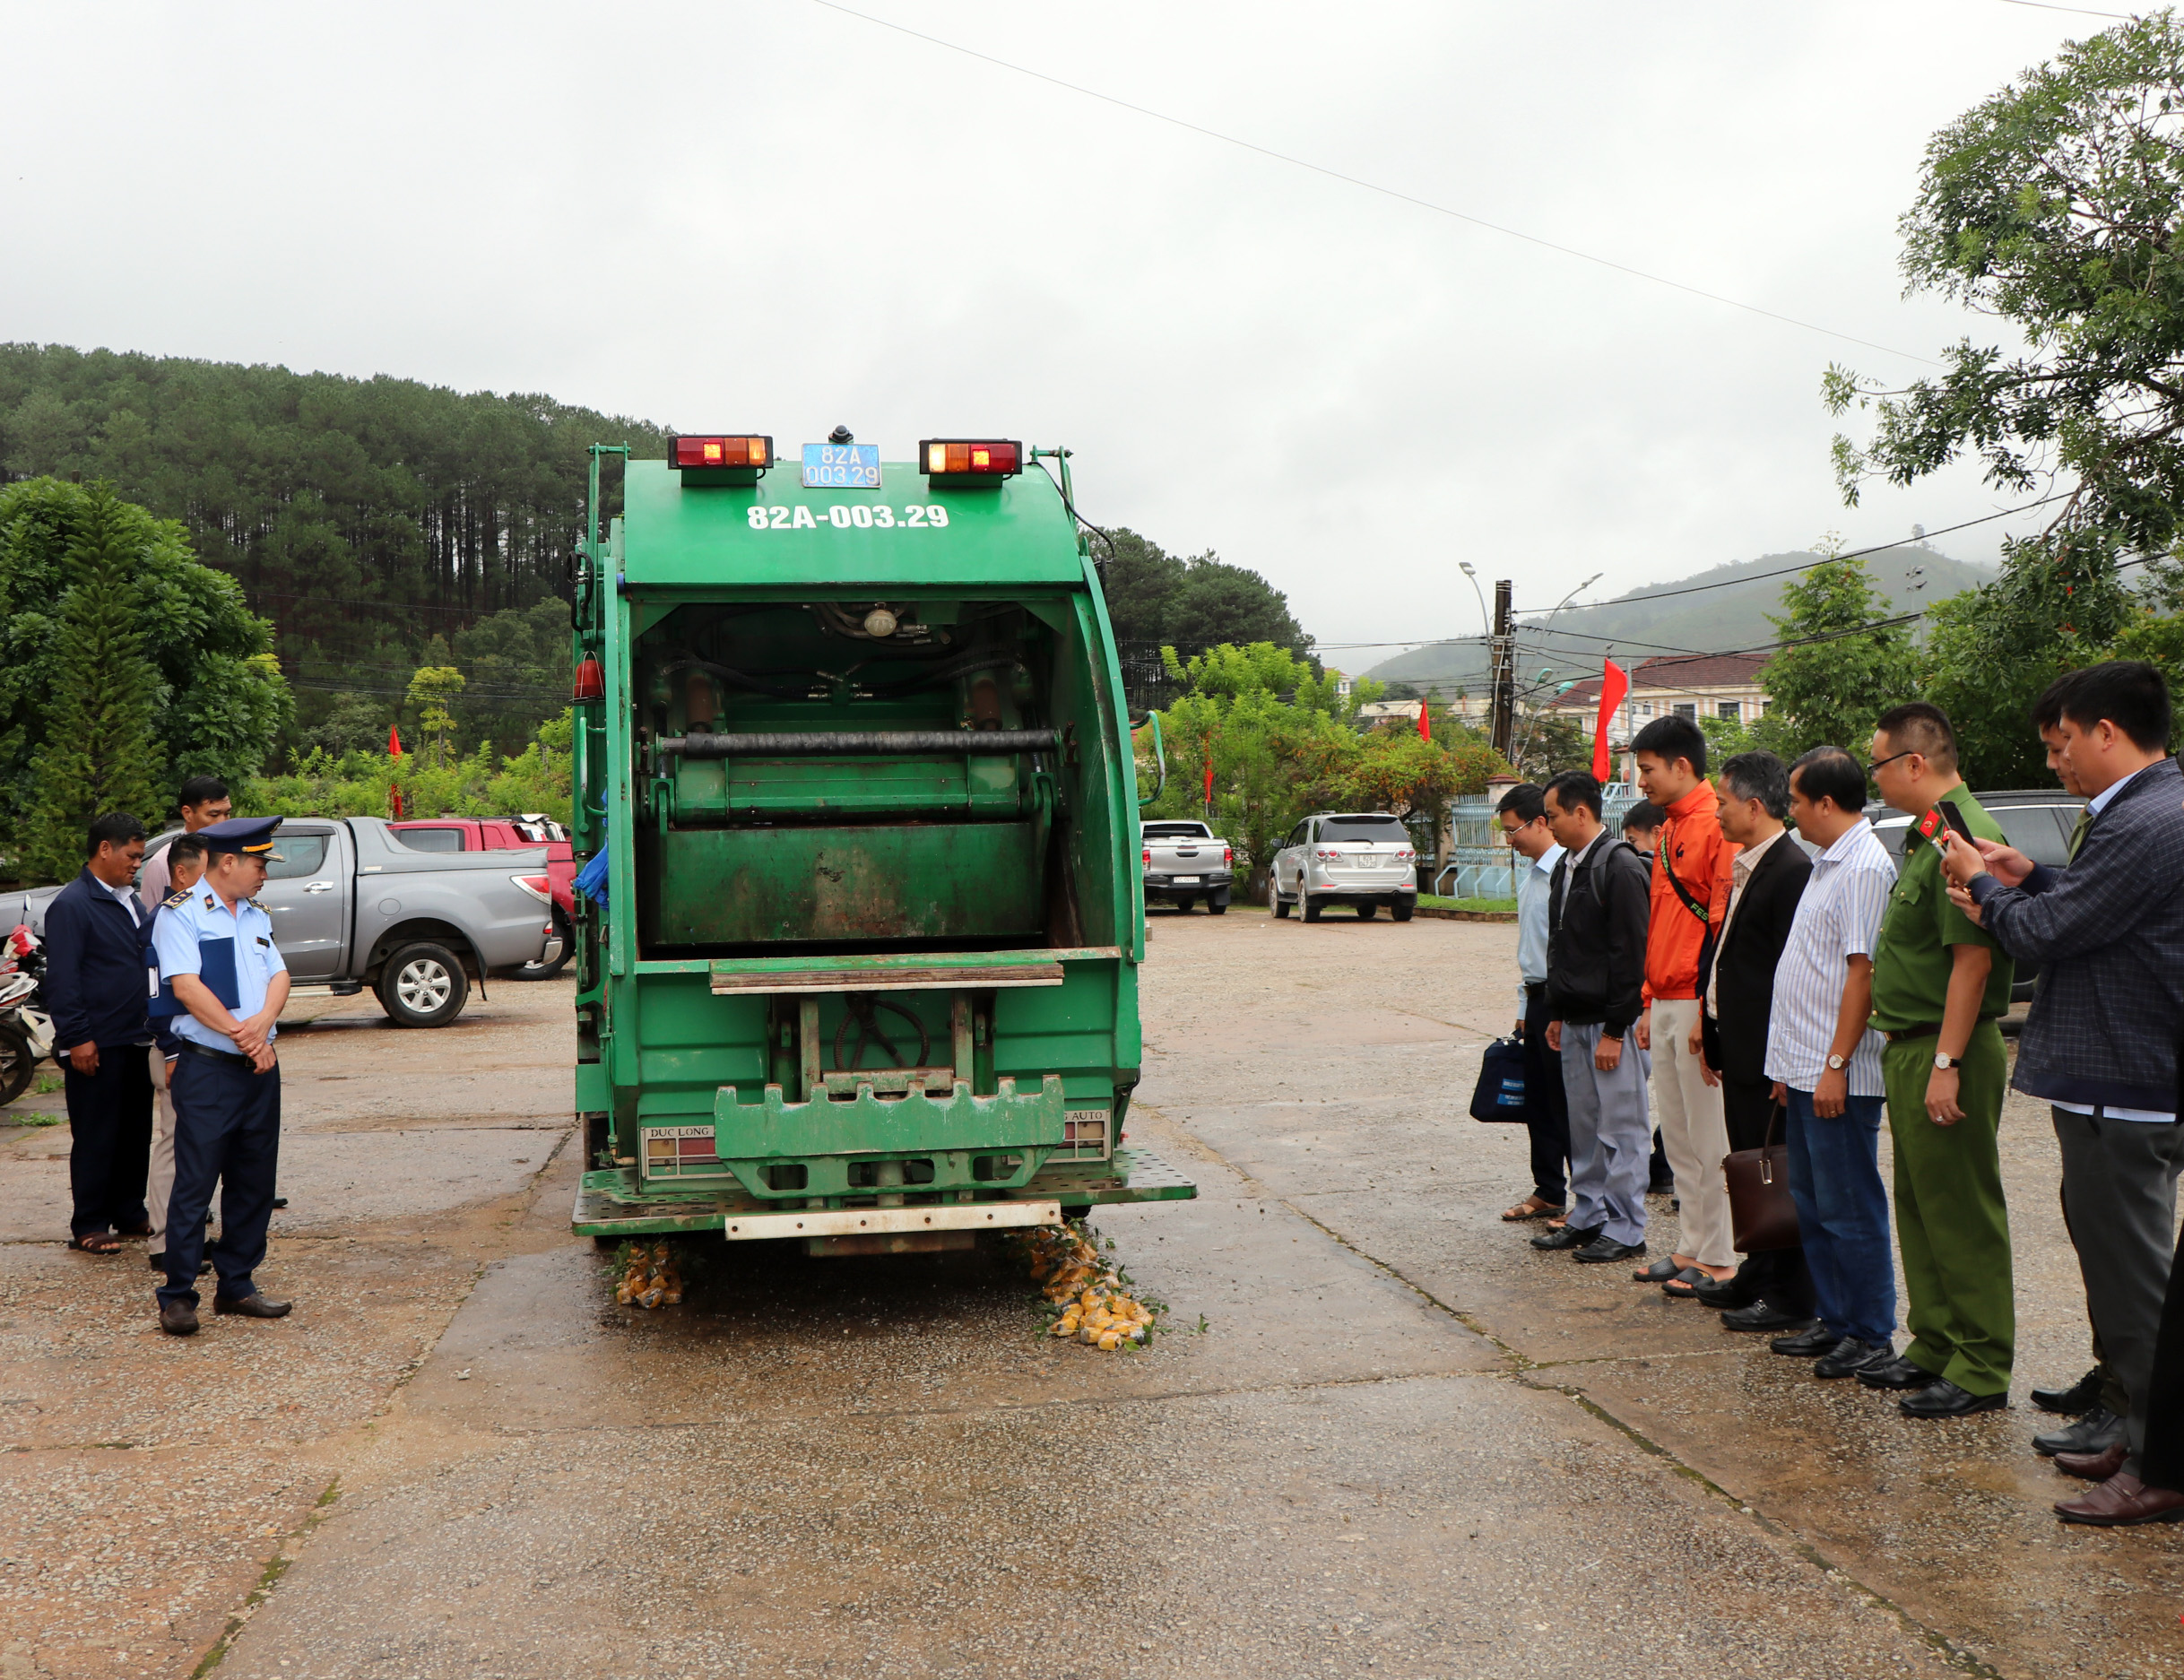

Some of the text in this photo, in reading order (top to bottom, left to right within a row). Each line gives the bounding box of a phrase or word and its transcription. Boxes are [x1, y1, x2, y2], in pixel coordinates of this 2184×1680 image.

[821, 446, 862, 464] 82A
[806, 465, 879, 485] 003.29
[747, 505, 949, 530] 82A-003.29
[1072, 1112, 1103, 1121] AUTO
[651, 1127, 709, 1138] DUC LONG
